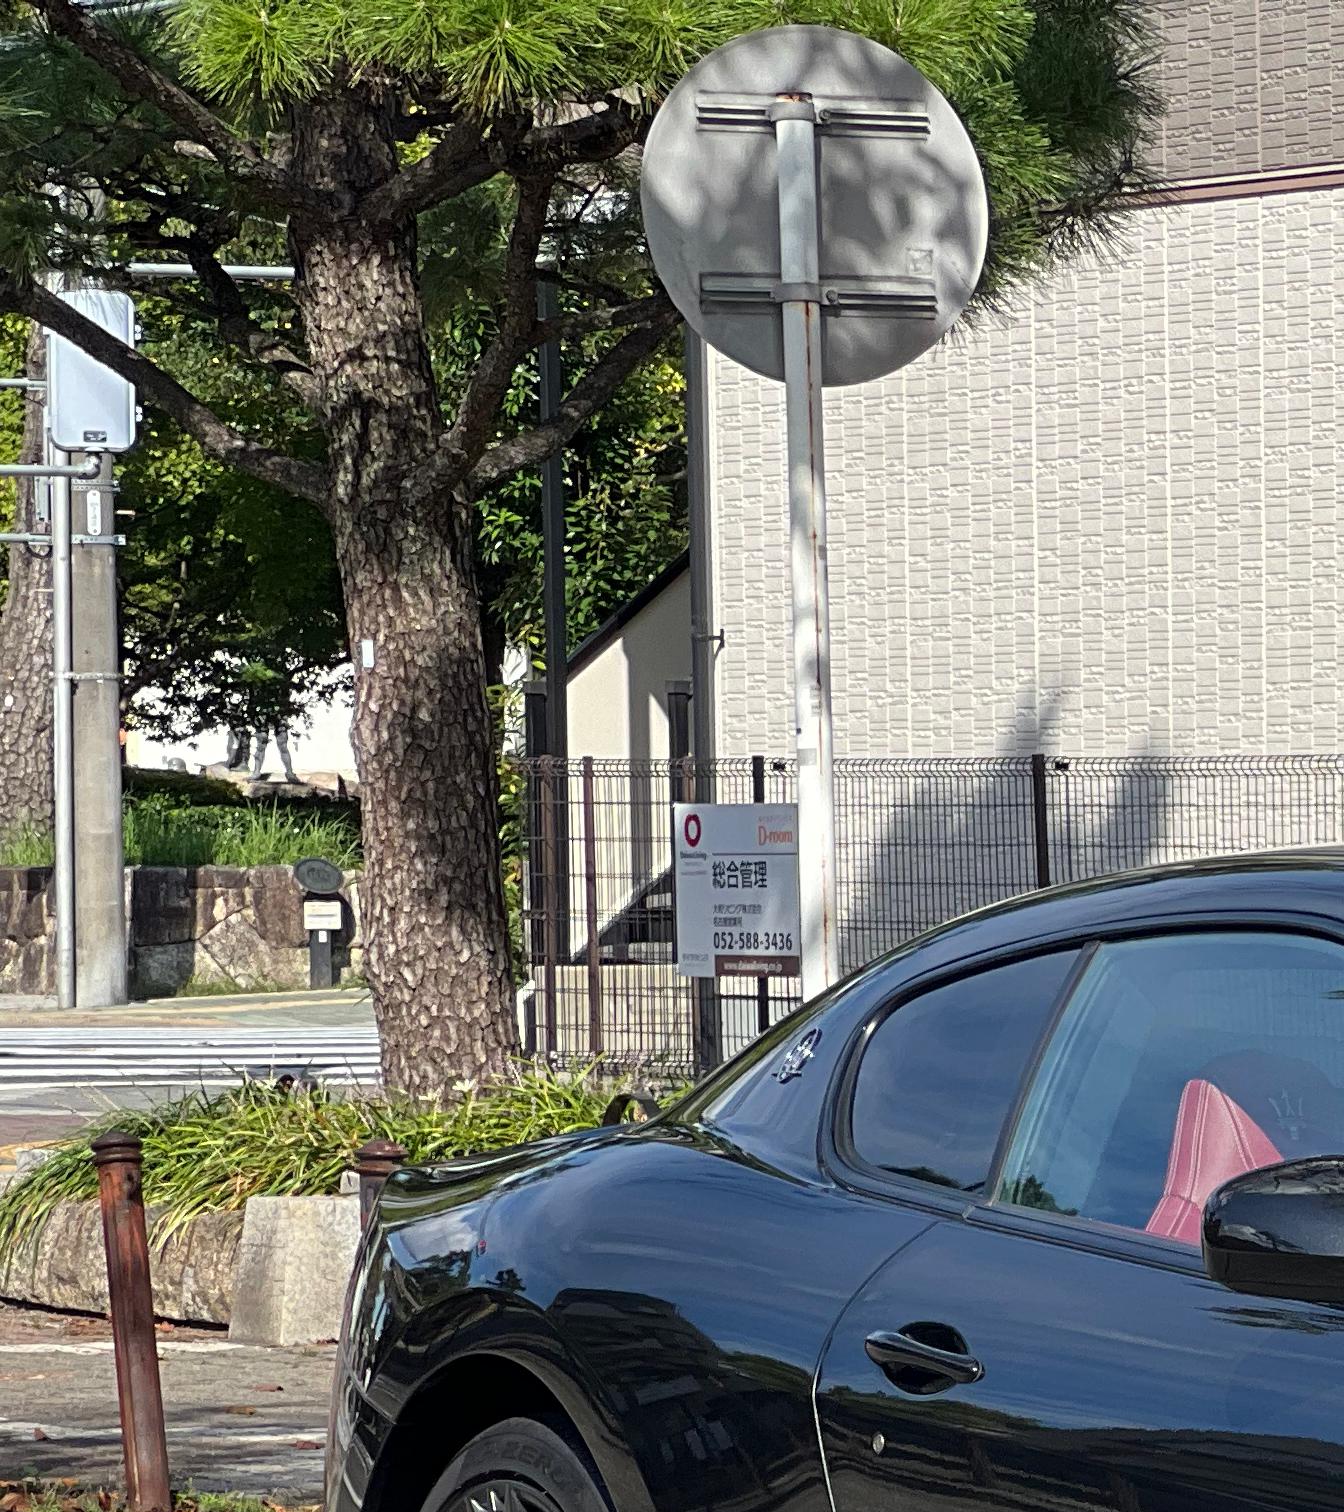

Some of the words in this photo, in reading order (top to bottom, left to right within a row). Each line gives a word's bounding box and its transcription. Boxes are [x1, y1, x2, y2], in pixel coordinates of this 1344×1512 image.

[758, 825, 793, 846] D-room
[712, 860, 768, 889] 総合管理
